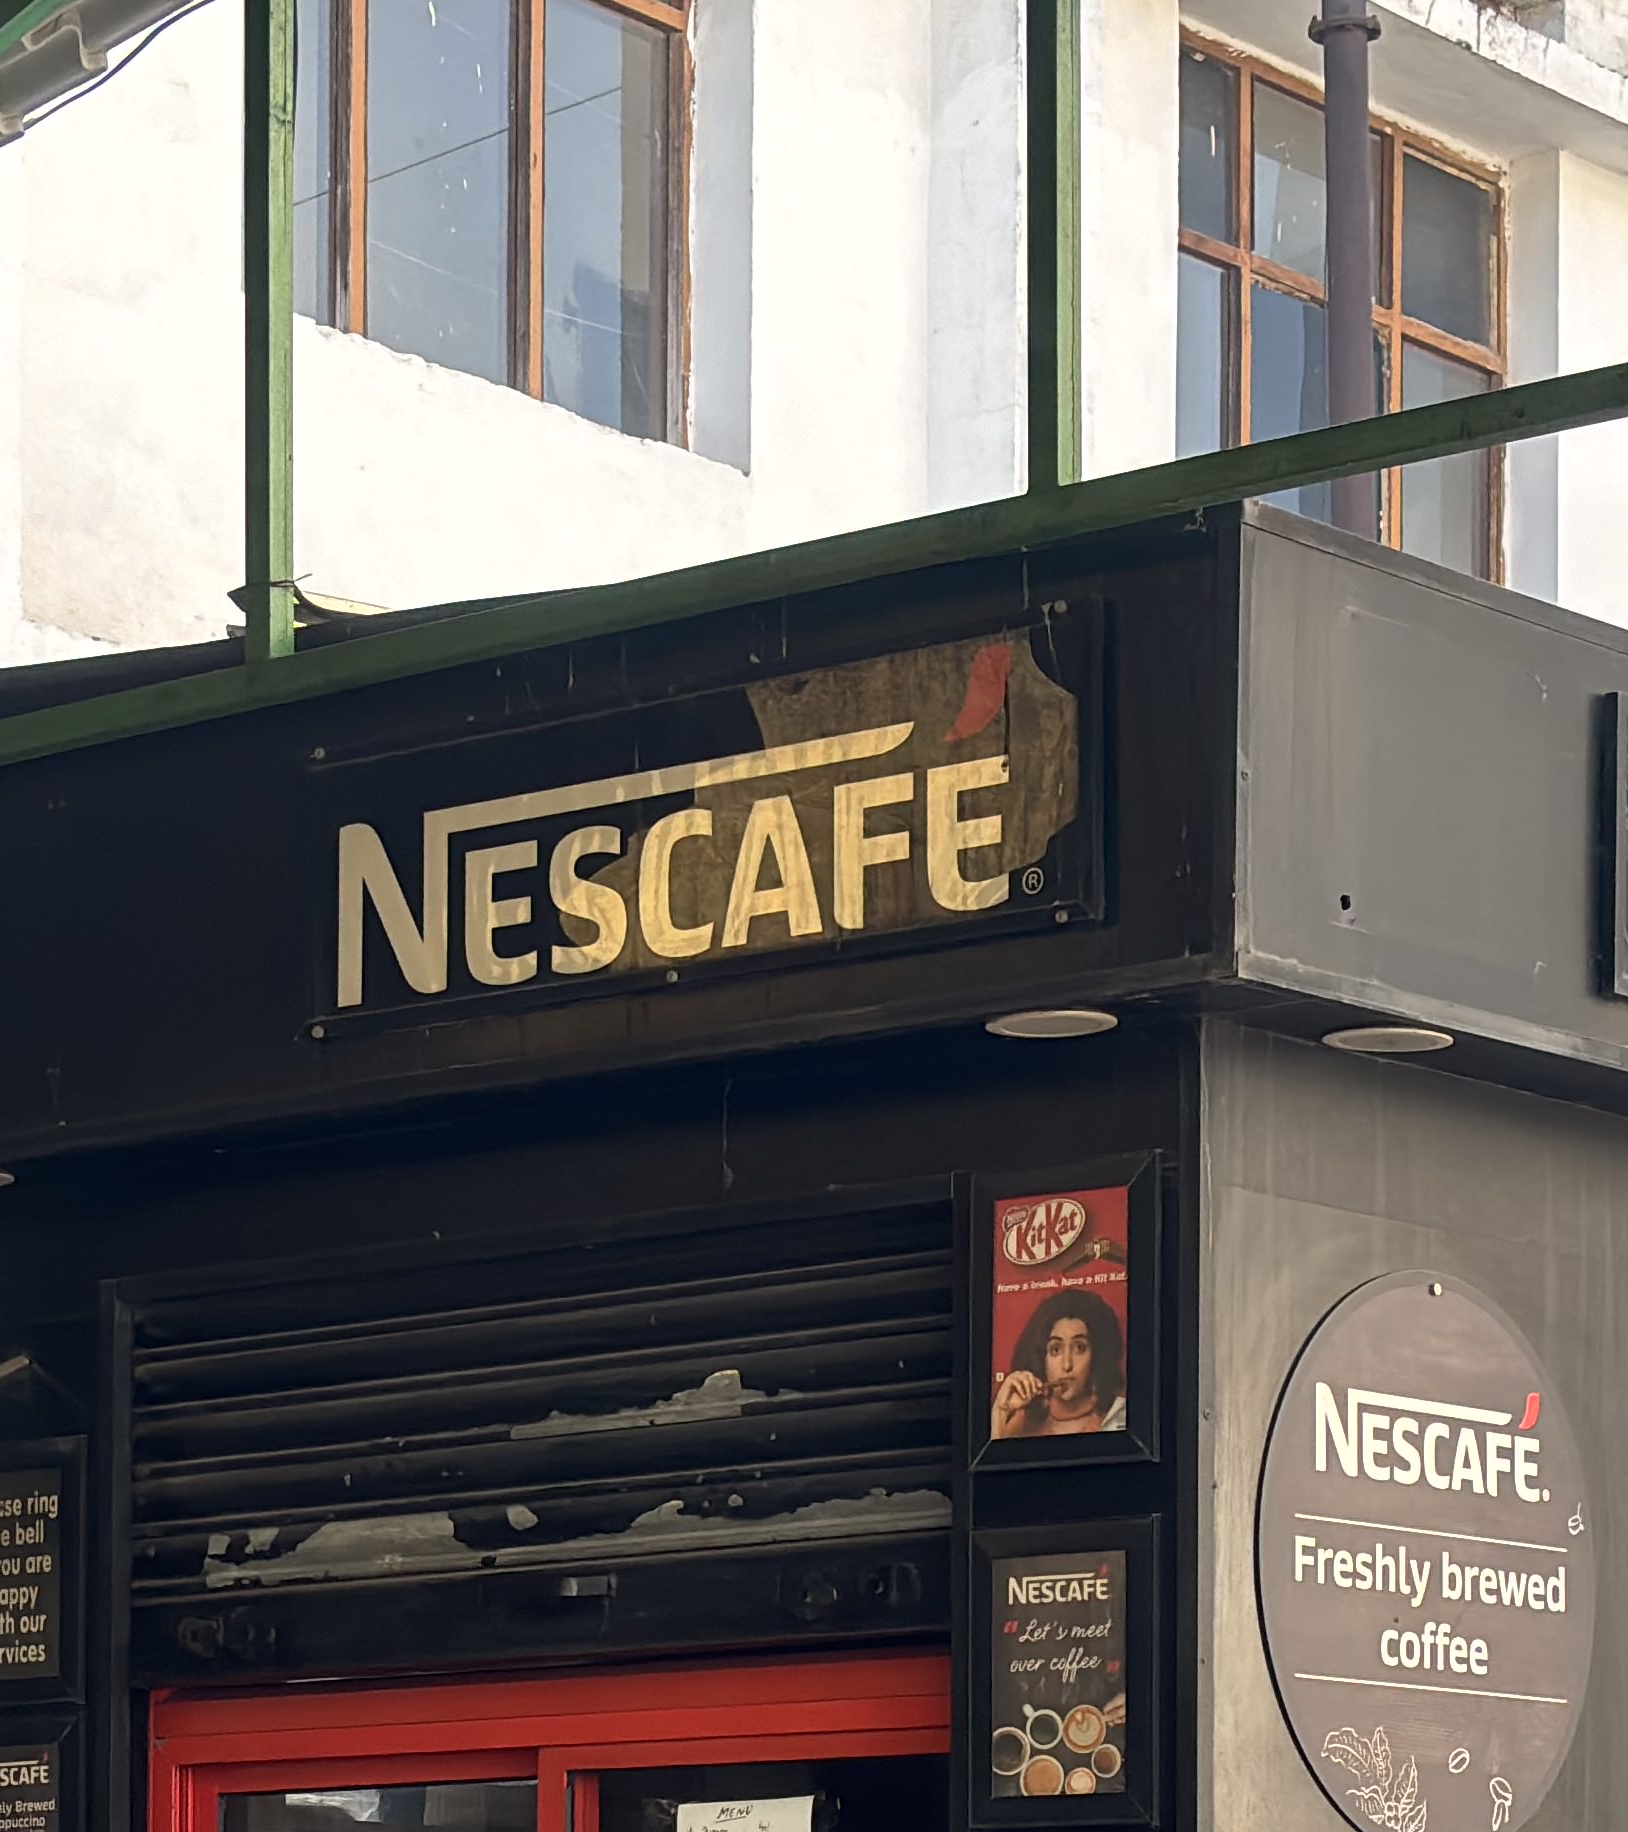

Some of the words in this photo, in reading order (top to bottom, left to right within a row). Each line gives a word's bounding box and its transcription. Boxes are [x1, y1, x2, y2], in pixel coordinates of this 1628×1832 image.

[27, 1490, 59, 1519] ring
[15, 1519, 45, 1546] bell
[25, 1553, 52, 1574] are
[1294, 1536, 1431, 1608] Freshly
[1442, 1551, 1567, 1613] brewed
[19, 1613, 47, 1634] our
[1071, 1617, 1112, 1640] meet
[1380, 1621, 1489, 1675] coffee
[1010, 1657, 1045, 1674] over
[15, 1798, 56, 1813] Brewed
[716, 1804, 754, 1819] MENU
